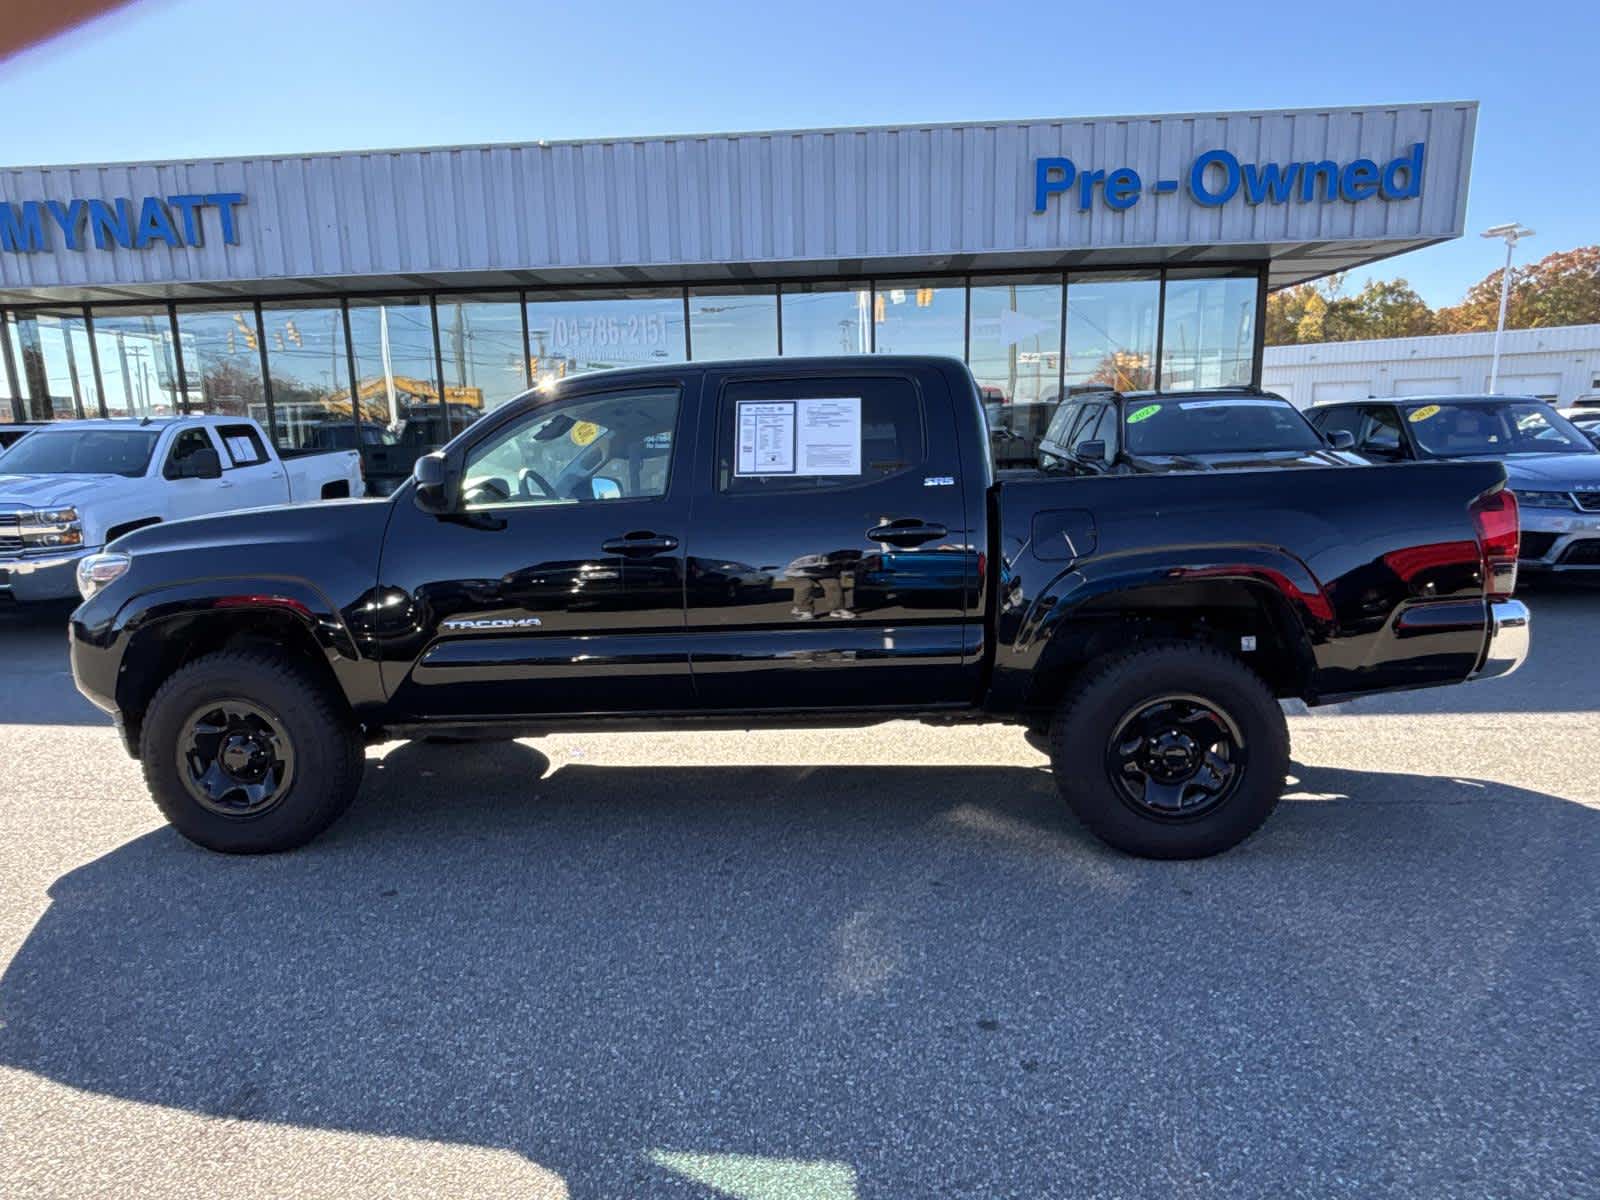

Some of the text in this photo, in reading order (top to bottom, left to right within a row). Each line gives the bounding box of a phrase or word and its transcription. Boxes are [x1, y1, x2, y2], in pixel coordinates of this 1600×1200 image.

[1033, 156, 1142, 213] Pre
[1190, 141, 1425, 208] Owned
[0, 193, 244, 252] MYNATT
[442, 617, 542, 630] TACOMA
